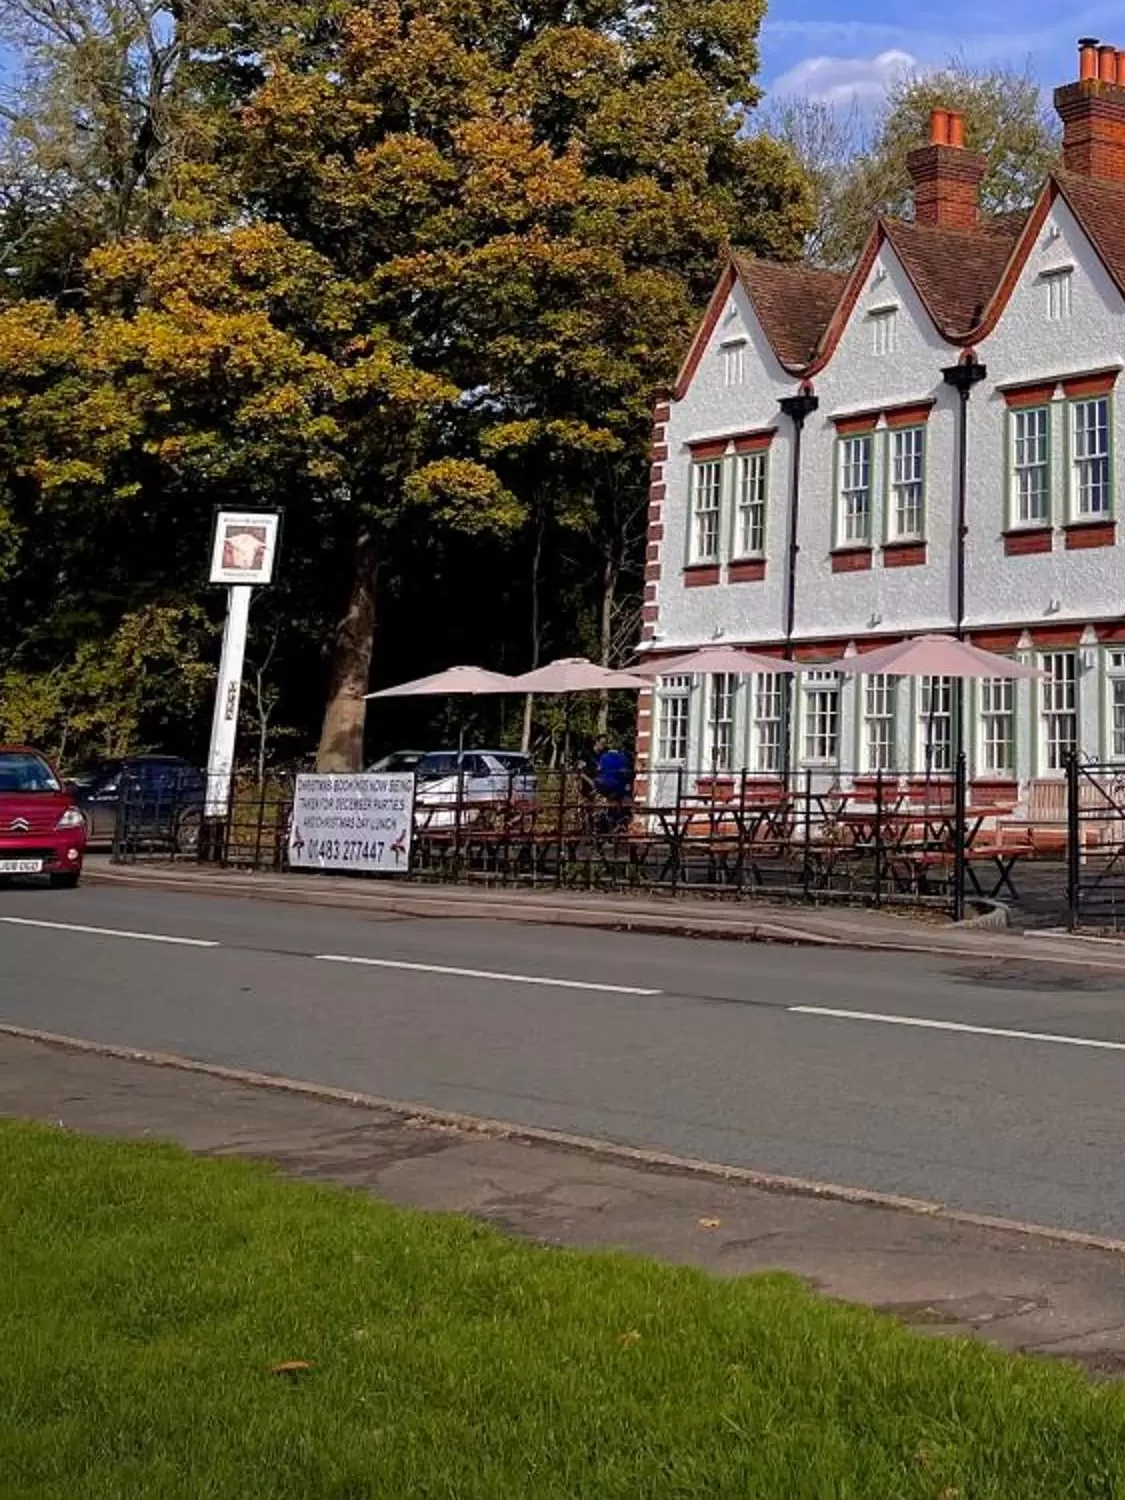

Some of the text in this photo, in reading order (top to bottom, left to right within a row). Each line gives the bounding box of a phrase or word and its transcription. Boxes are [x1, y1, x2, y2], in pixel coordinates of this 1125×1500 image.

[370, 779, 389, 792] NOW
[390, 779, 413, 792] BEING
[307, 839, 385, 862] 01483 277447
